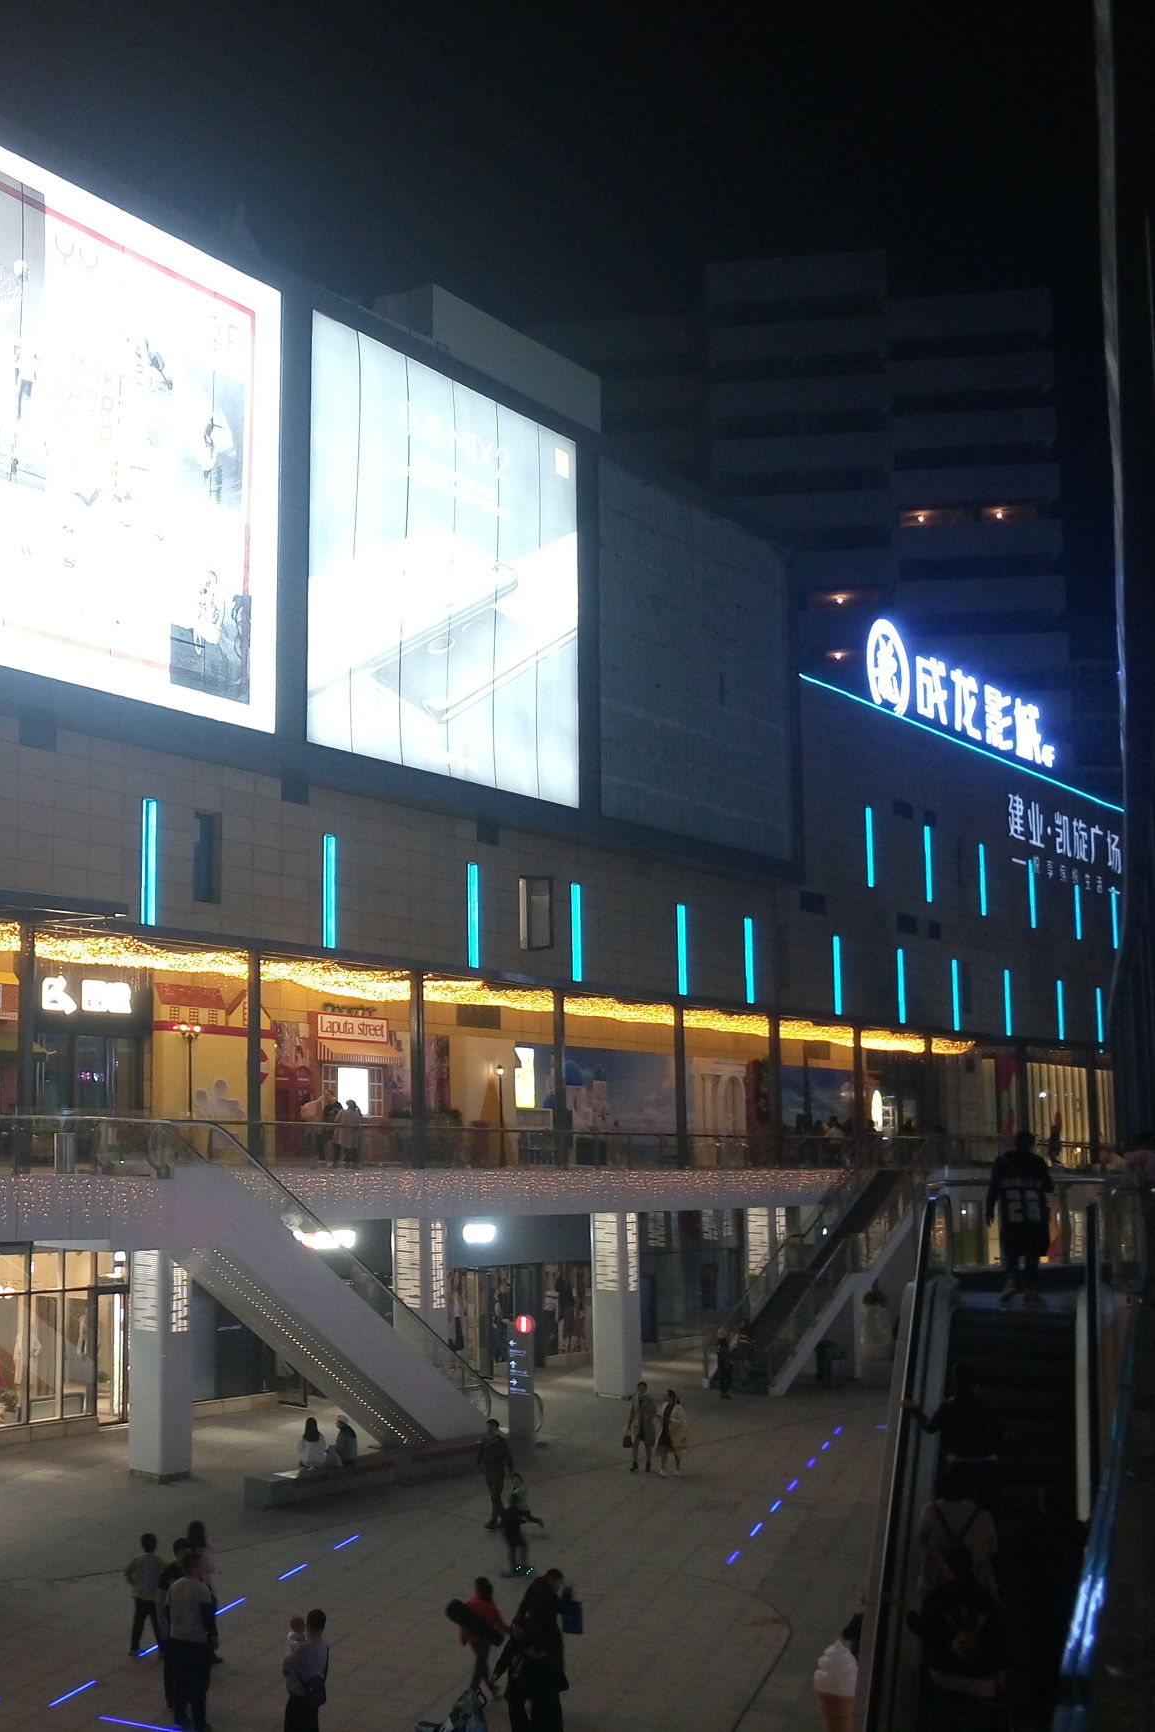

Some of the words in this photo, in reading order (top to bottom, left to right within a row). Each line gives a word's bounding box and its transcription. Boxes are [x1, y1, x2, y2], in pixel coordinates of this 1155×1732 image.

[915, 656, 1042, 764] 成龙影城
[1008, 793, 1122, 875] 建业·凯旋广场
[320, 1016, 354, 1036] Laputa
[357, 1021, 385, 1038] street
